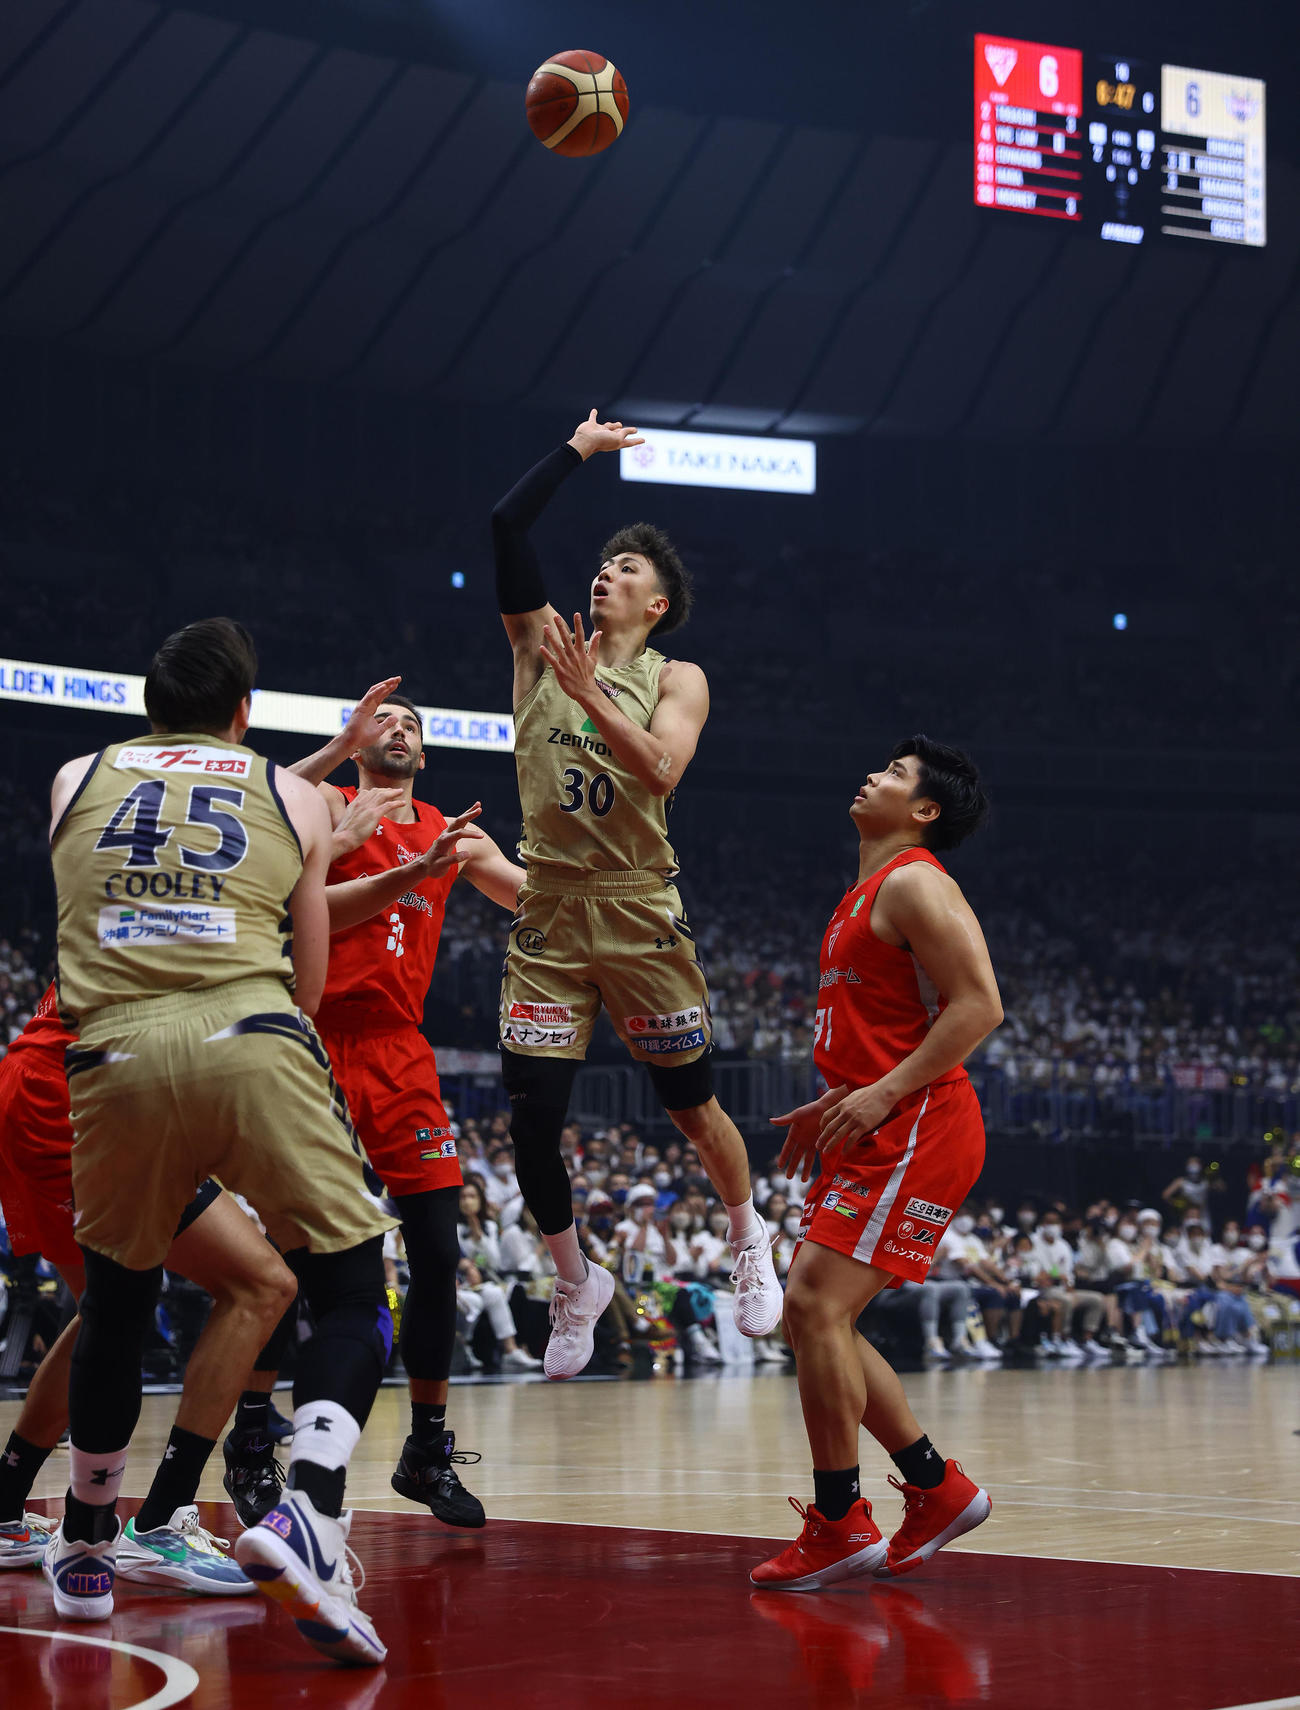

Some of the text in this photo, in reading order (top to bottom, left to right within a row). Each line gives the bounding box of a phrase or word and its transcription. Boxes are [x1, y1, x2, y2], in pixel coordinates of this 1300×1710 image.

[1039, 55, 1059, 97] 6
[1186, 82, 1200, 118] 6
[429, 715, 509, 741] GOLDEN
[547, 727, 613, 757] Zenho
[558, 767, 616, 818] 30
[93, 780, 249, 873] 45
[105, 871, 227, 902] COOLEY
[140, 909, 211, 922] FamilyMart
[103, 923, 229, 941] 沖縄ファミリーマート
[647, 1011, 699, 1030] 琉球銀行
[519, 1028, 576, 1045] ナンセイ
[67, 1571, 111, 1594] NIKE
